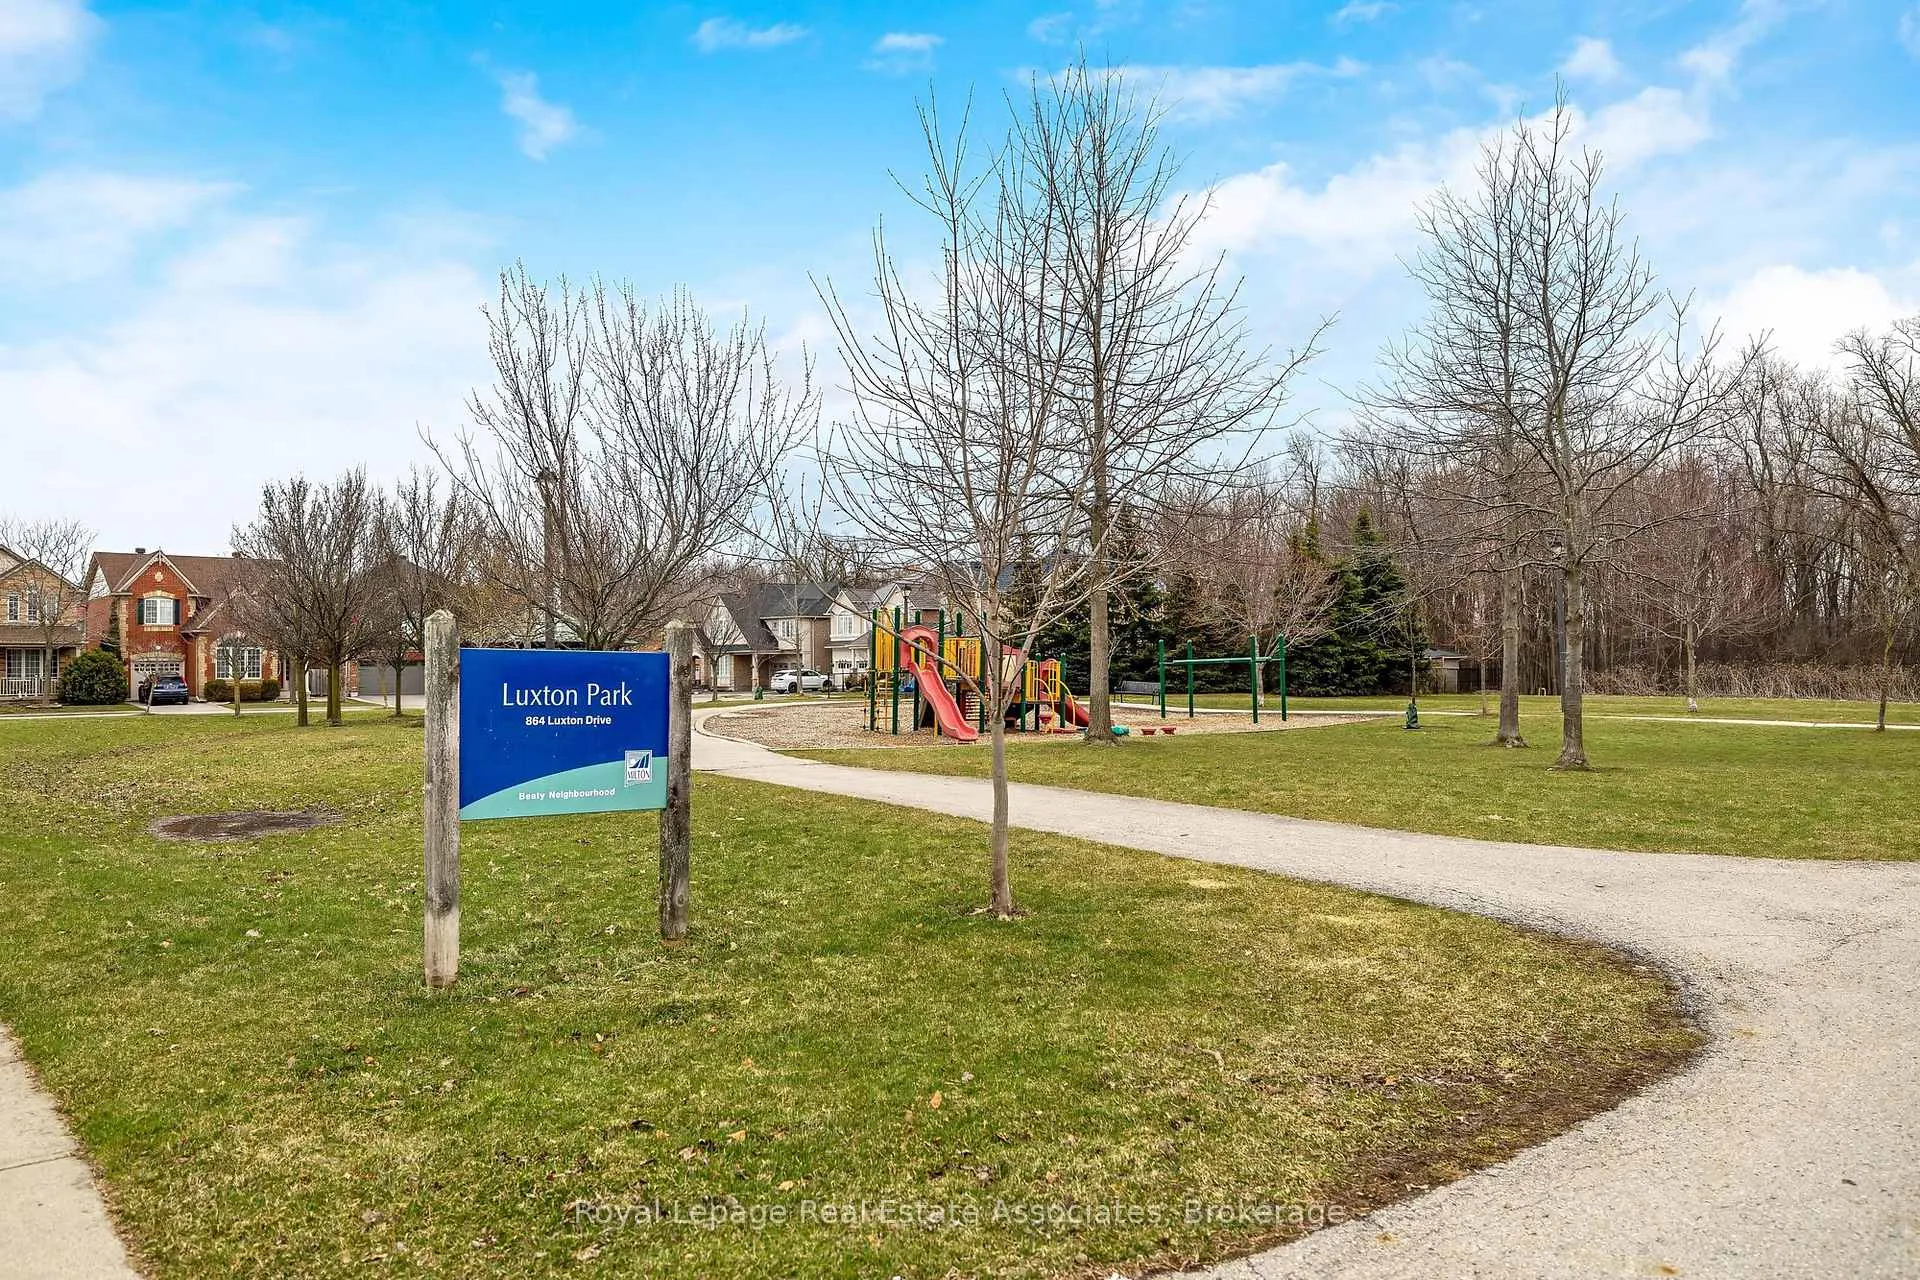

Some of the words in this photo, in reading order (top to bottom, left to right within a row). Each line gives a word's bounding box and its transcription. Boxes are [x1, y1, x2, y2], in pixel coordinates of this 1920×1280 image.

[503, 682, 578, 706] Luxton
[587, 681, 632, 706] Park
[525, 716, 545, 726] 864
[547, 716, 583, 725] Luxton
[585, 715, 612, 725] Drive
[519, 791, 545, 801] Beaty
[548, 787, 616, 800] Neighbourhood
